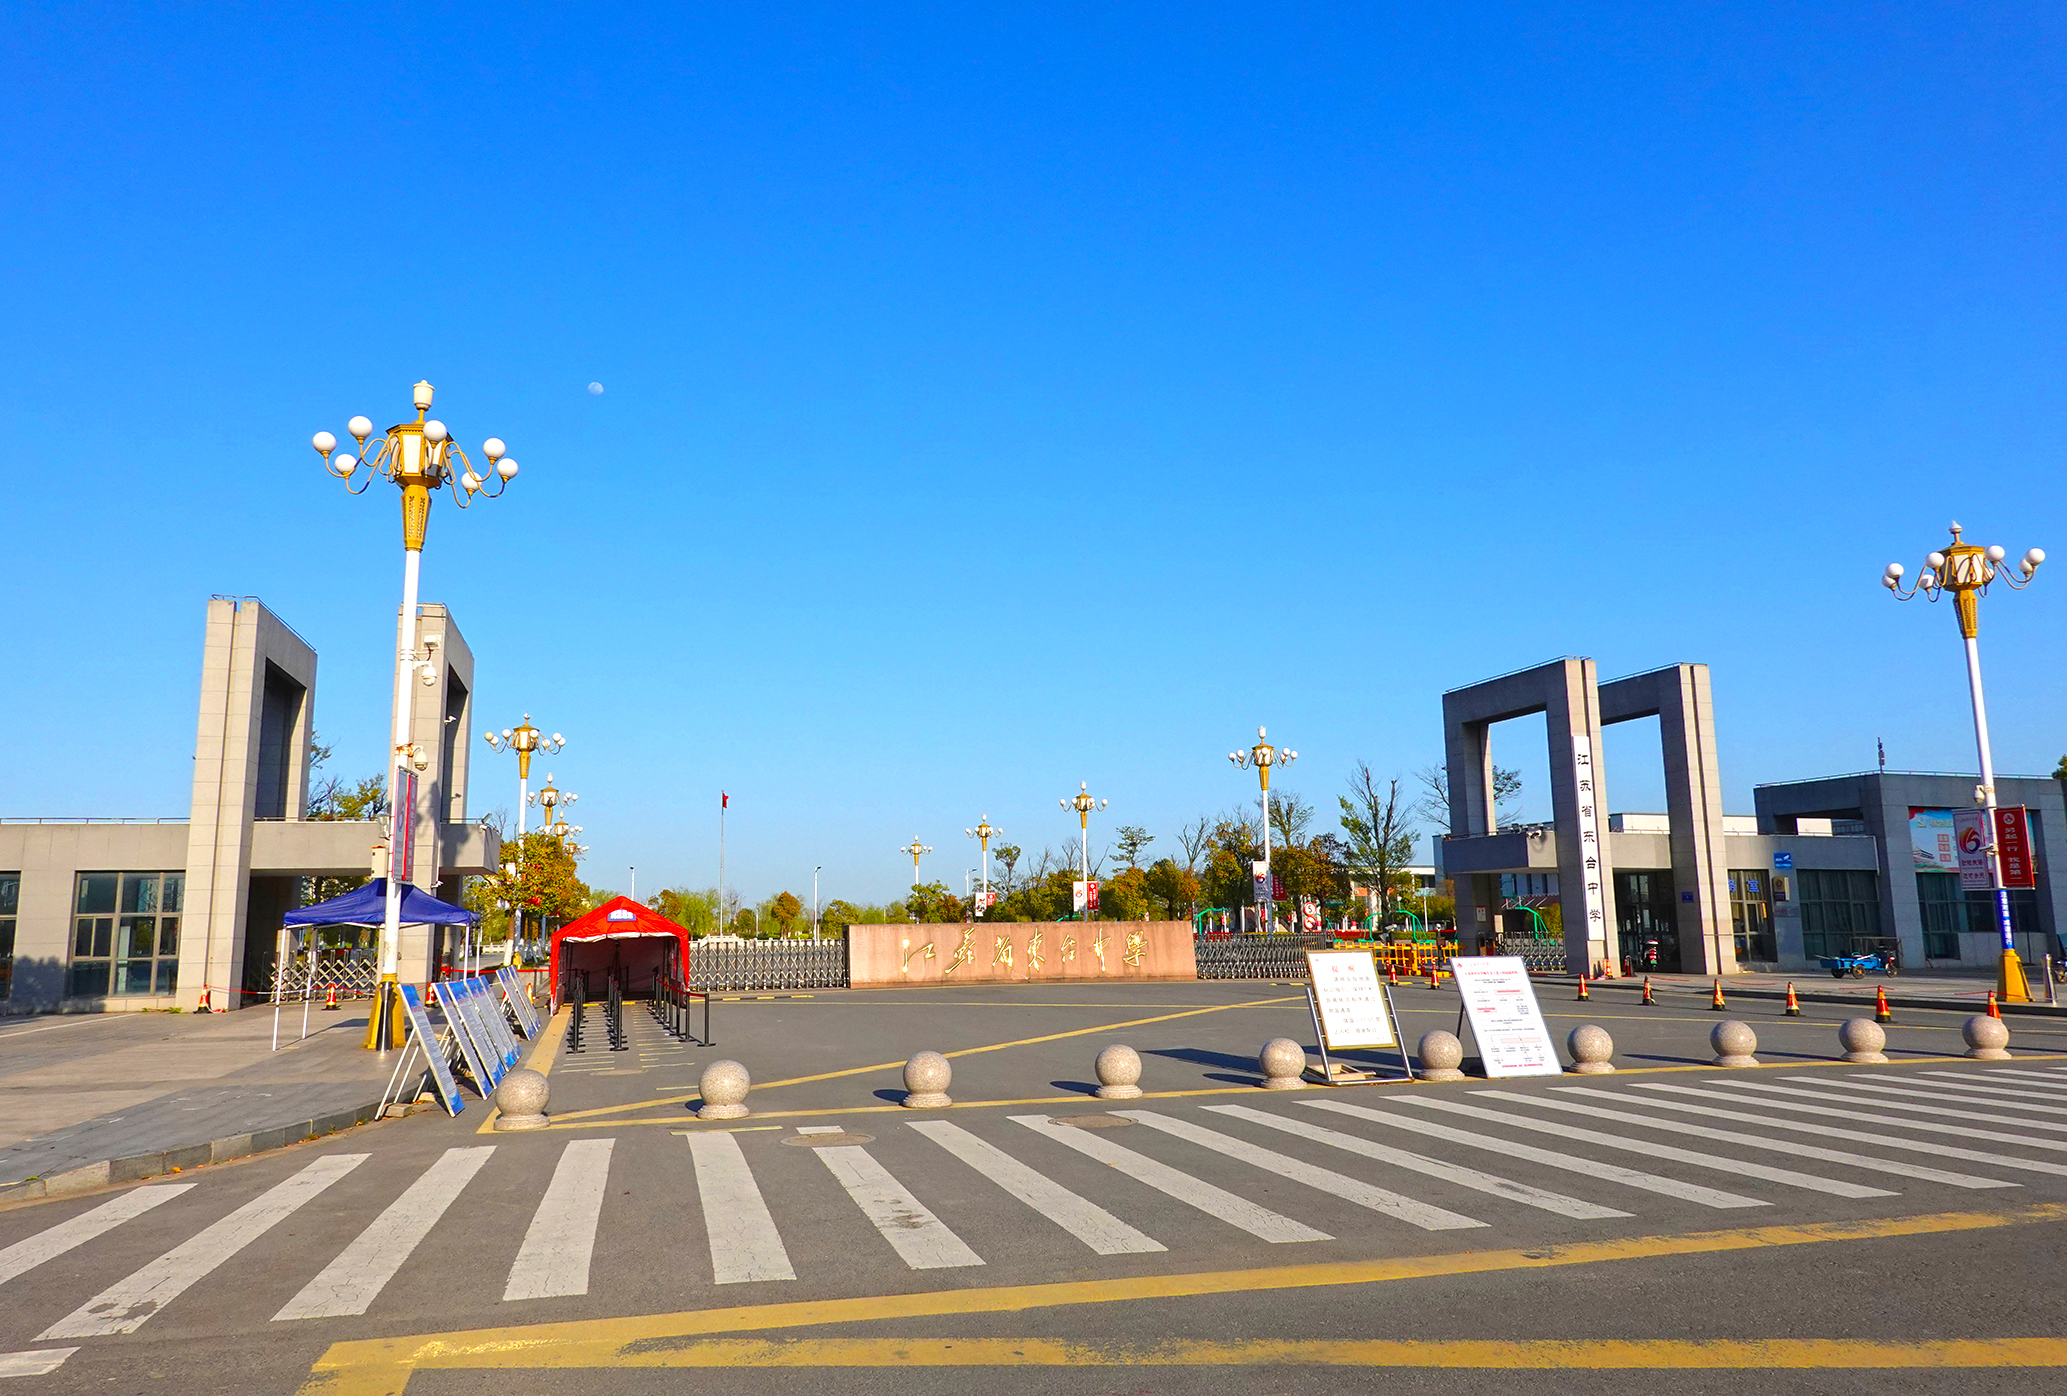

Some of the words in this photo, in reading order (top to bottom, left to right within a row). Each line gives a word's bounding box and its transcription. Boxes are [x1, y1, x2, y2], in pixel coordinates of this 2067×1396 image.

[1577, 753, 1602, 922] 江苏省东台中学
